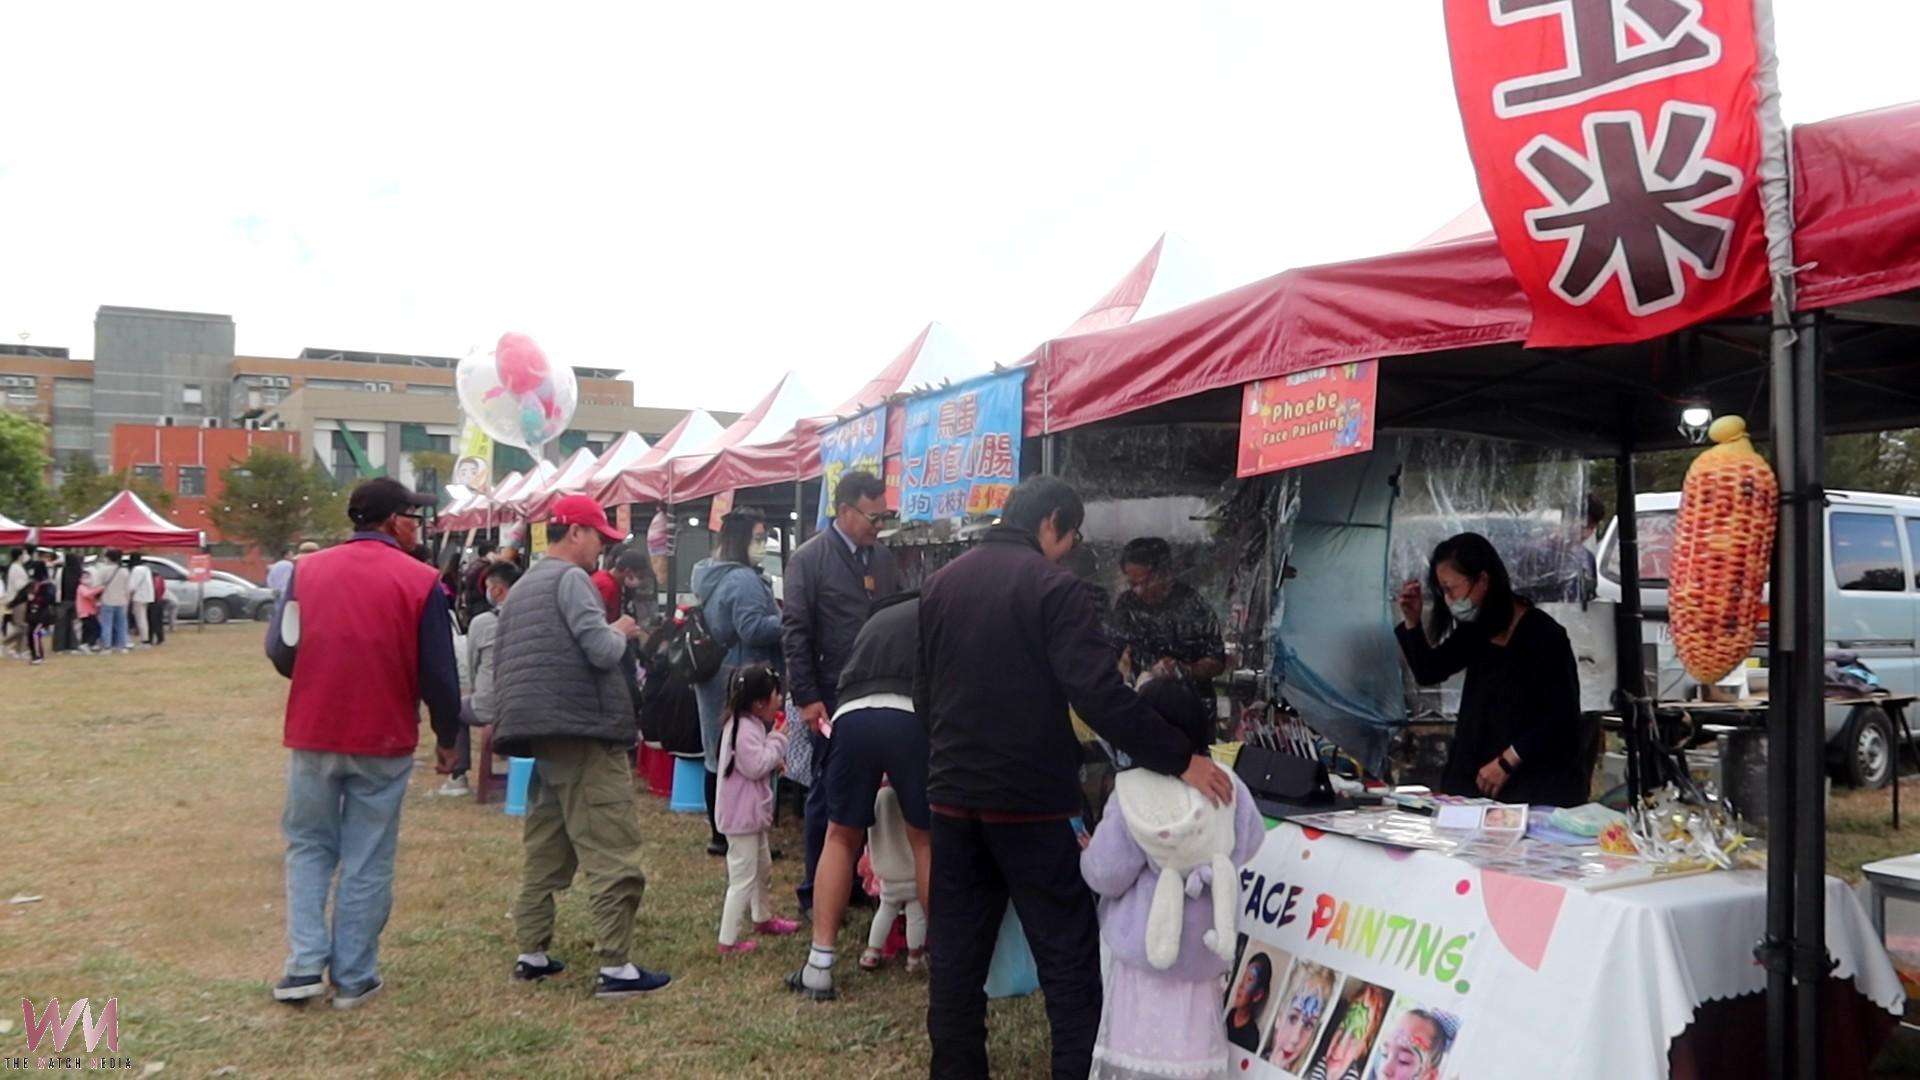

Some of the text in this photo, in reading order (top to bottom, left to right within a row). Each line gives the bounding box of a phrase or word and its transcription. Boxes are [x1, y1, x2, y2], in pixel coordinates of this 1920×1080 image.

[1493, 0, 1744, 316] 玉米
[1263, 416, 1346, 446] Face Painting
[1272, 392, 1337, 423] Phoebe
[1240, 867, 1468, 983] FACE PAINTING
